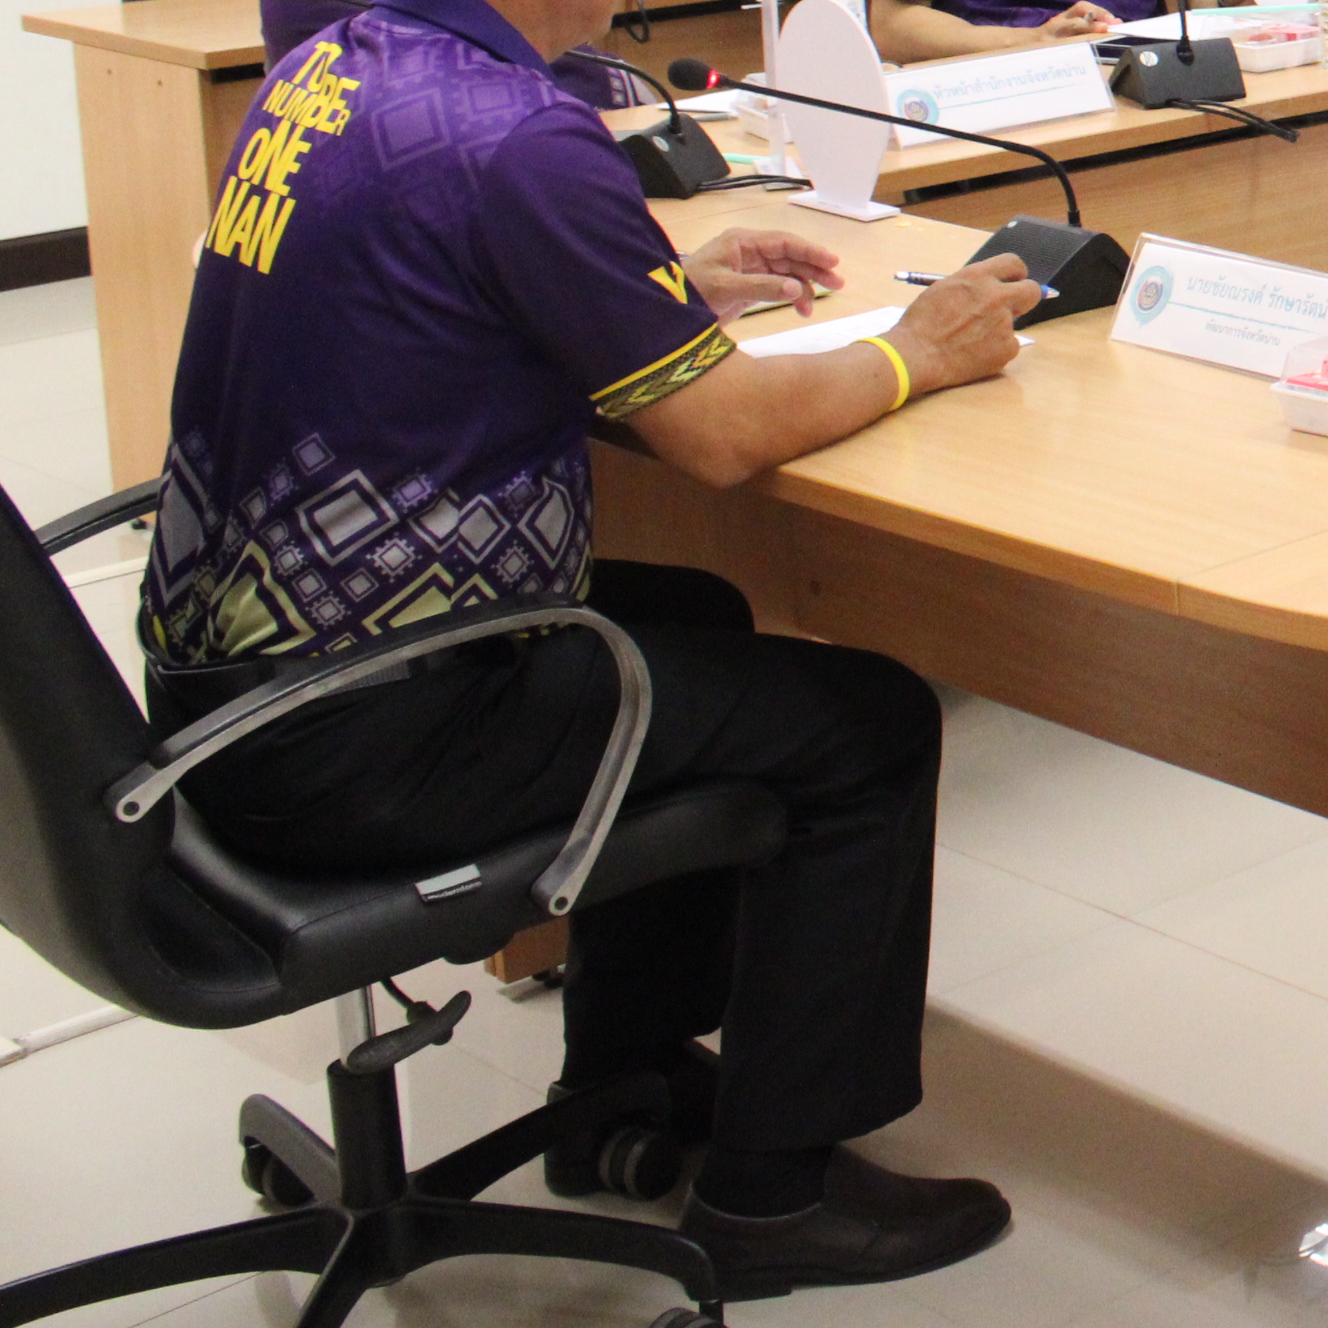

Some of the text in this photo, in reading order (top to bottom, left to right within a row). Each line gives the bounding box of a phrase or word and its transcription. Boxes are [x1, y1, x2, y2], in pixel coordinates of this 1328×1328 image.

[262, 79, 351, 136] NUMBER
[238, 118, 312, 196] ONE
[205, 175, 296, 275] NAN
[1186, 274, 1268, 305] นายชัยณรงค์
